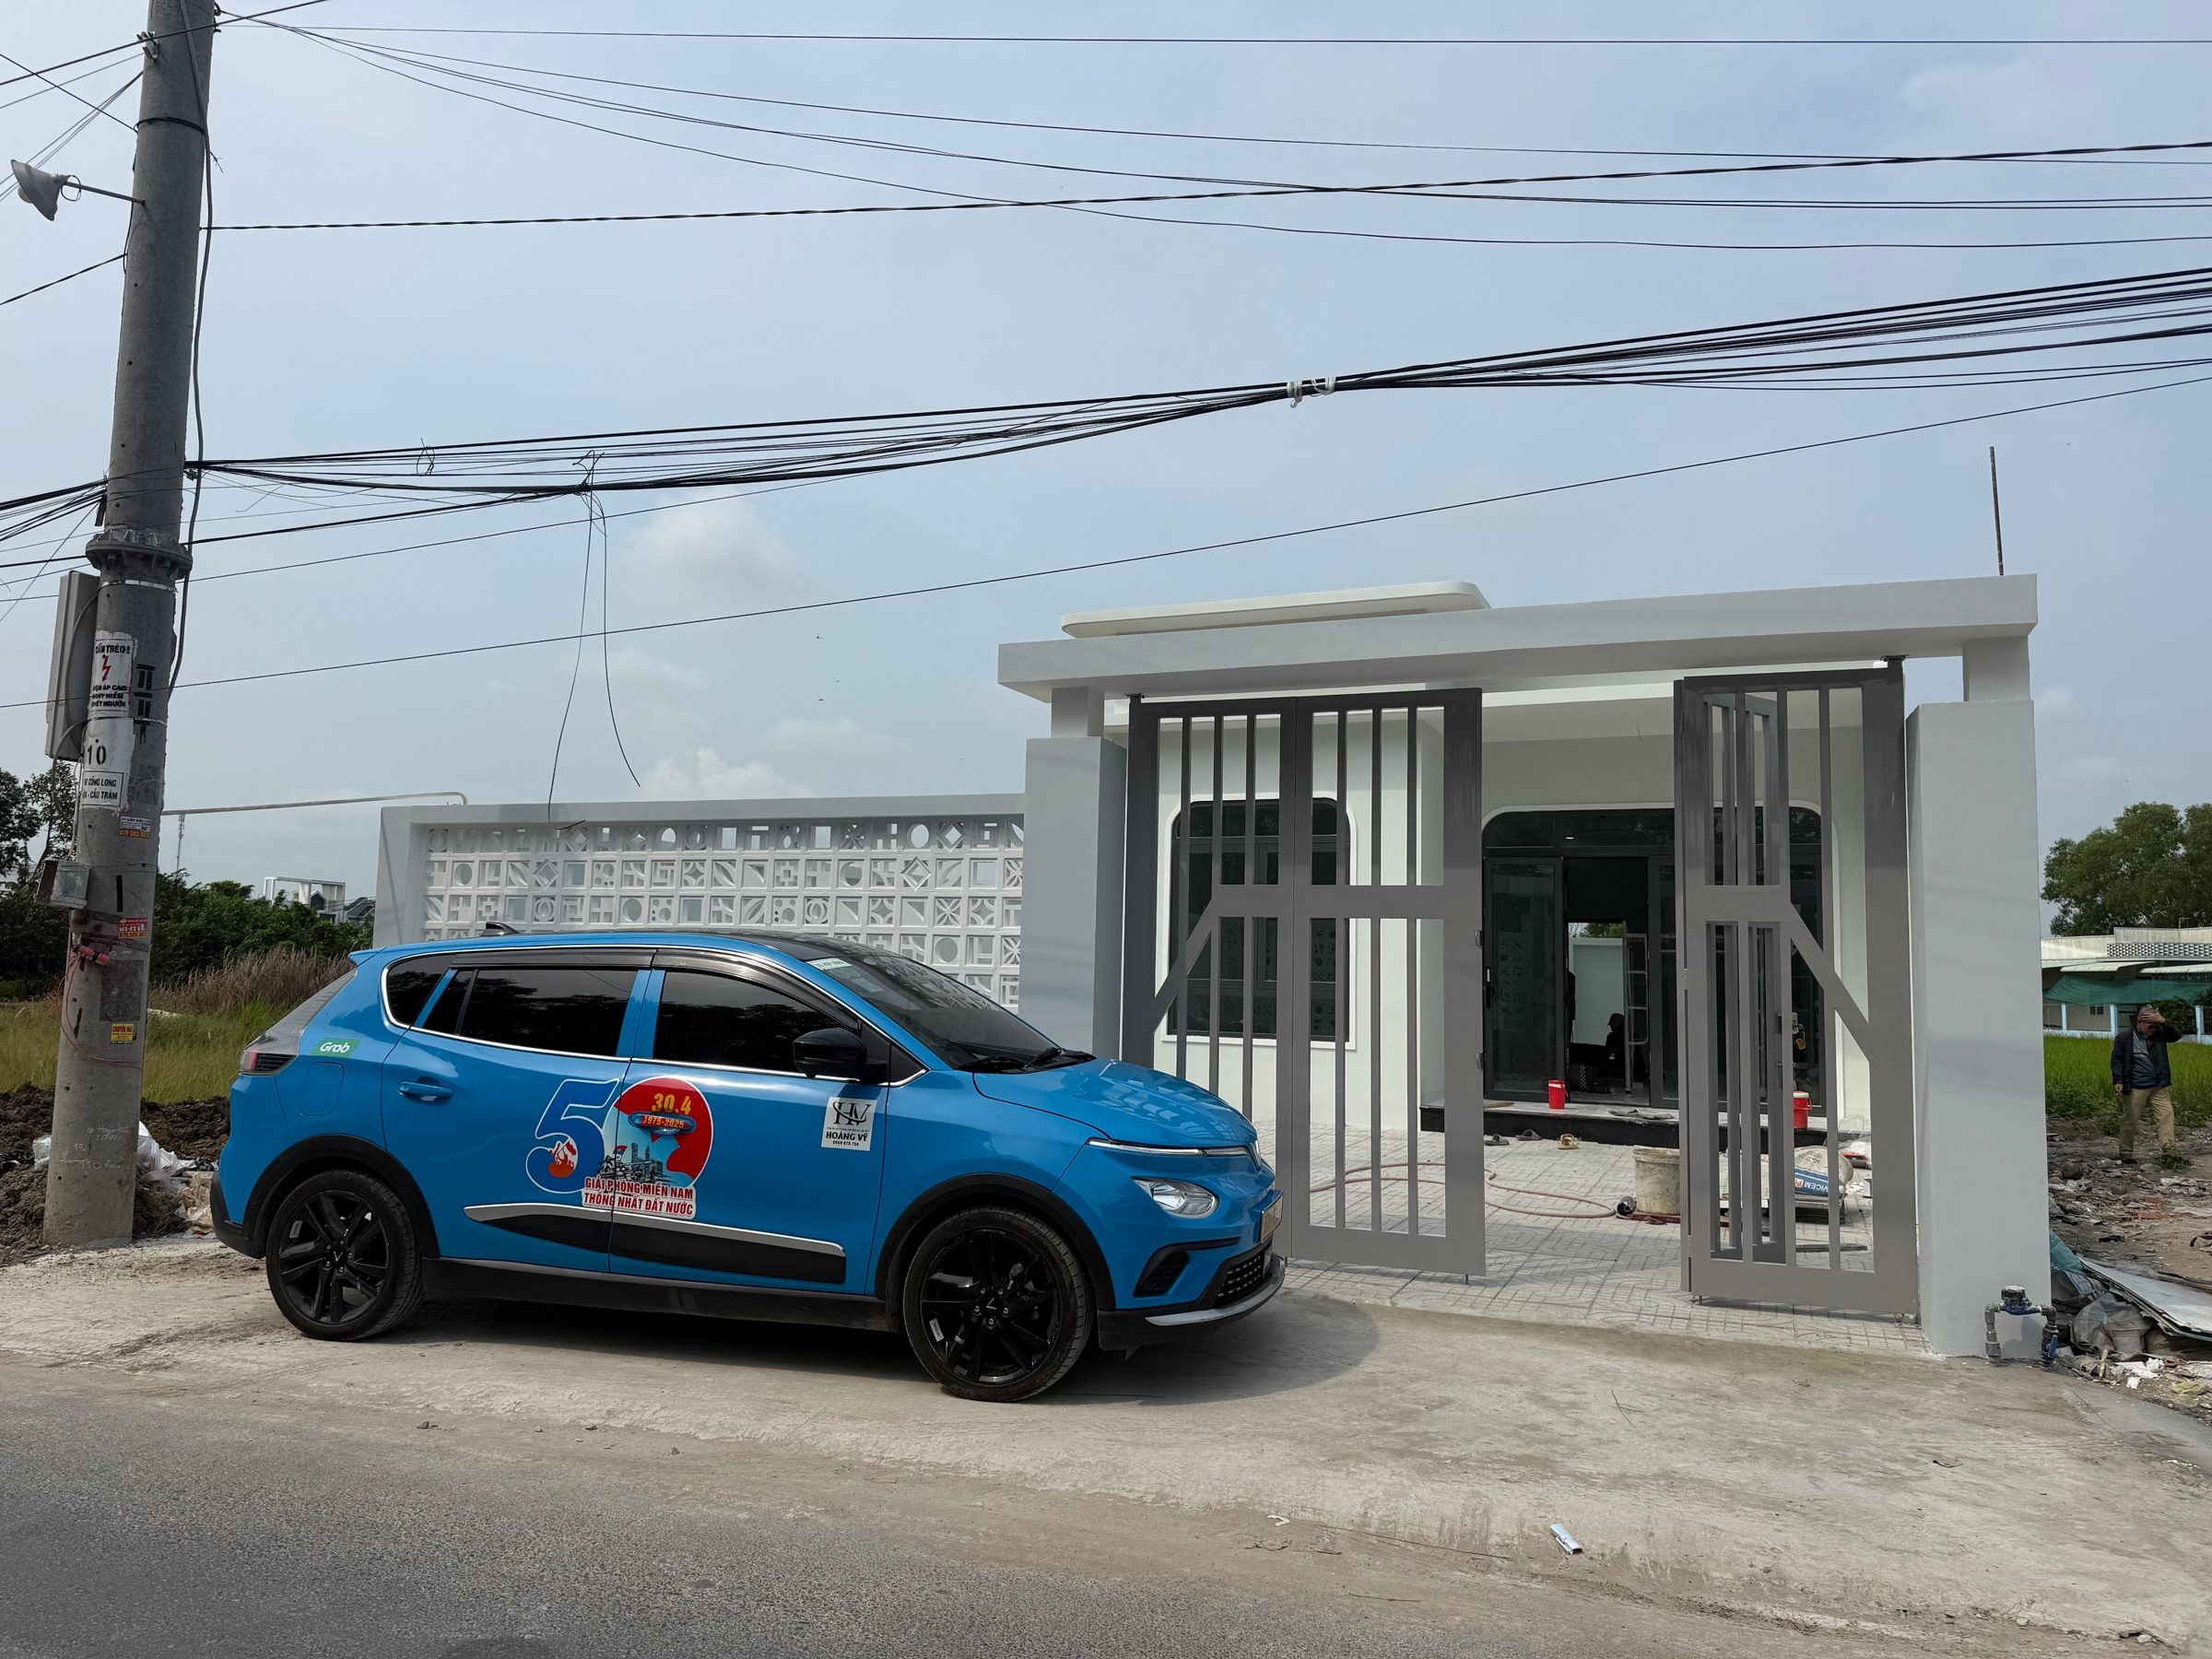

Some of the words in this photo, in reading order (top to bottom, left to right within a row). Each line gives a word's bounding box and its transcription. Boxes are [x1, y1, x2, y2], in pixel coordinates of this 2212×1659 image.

[87, 745, 107, 766] 10
[100, 778, 117, 787] LONG
[320, 1041, 350, 1053] Grab
[652, 1093, 691, 1115] 30.4
[643, 1115, 685, 1129] 1975-2025
[826, 1131, 855, 1141] HOÀNG
[585, 1175, 605, 1189] GIẢI
[607, 1179, 641, 1194] PHÓNG
[670, 1186, 693, 1199] NAM
[584, 1191, 615, 1206] THỐNG
[618, 1195, 643, 1209] NHẤT
[665, 1200, 693, 1215] NƯỚC
